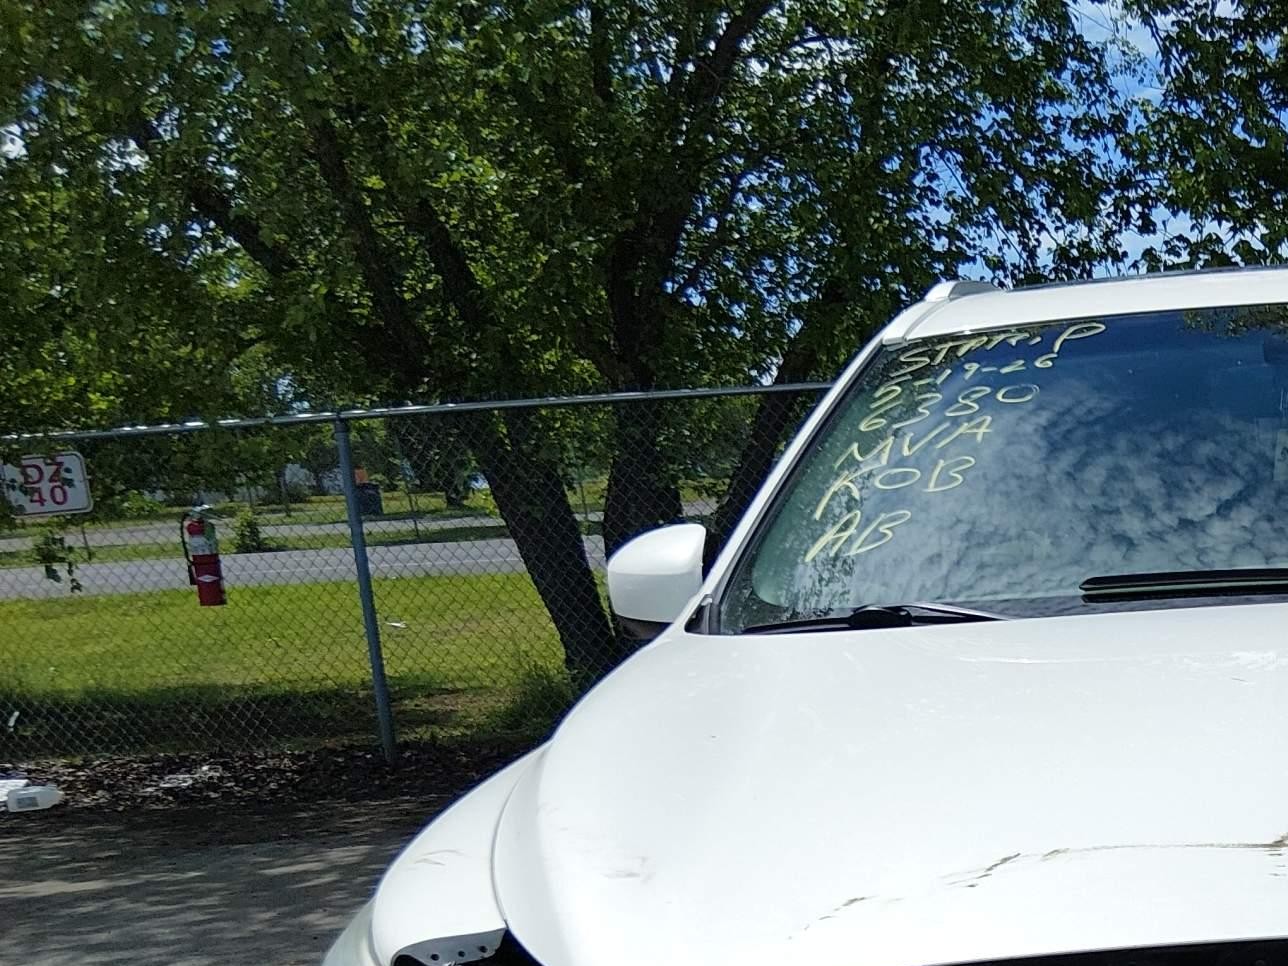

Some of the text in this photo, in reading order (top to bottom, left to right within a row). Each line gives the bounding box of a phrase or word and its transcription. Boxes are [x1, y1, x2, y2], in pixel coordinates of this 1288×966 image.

[859, 384, 1040, 432] 6380
[833, 415, 993, 470] MVA
[22, 460, 64, 485] DZ
[30, 485, 68, 507] 40
[815, 456, 976, 520] KOB
[804, 510, 912, 562] AB
